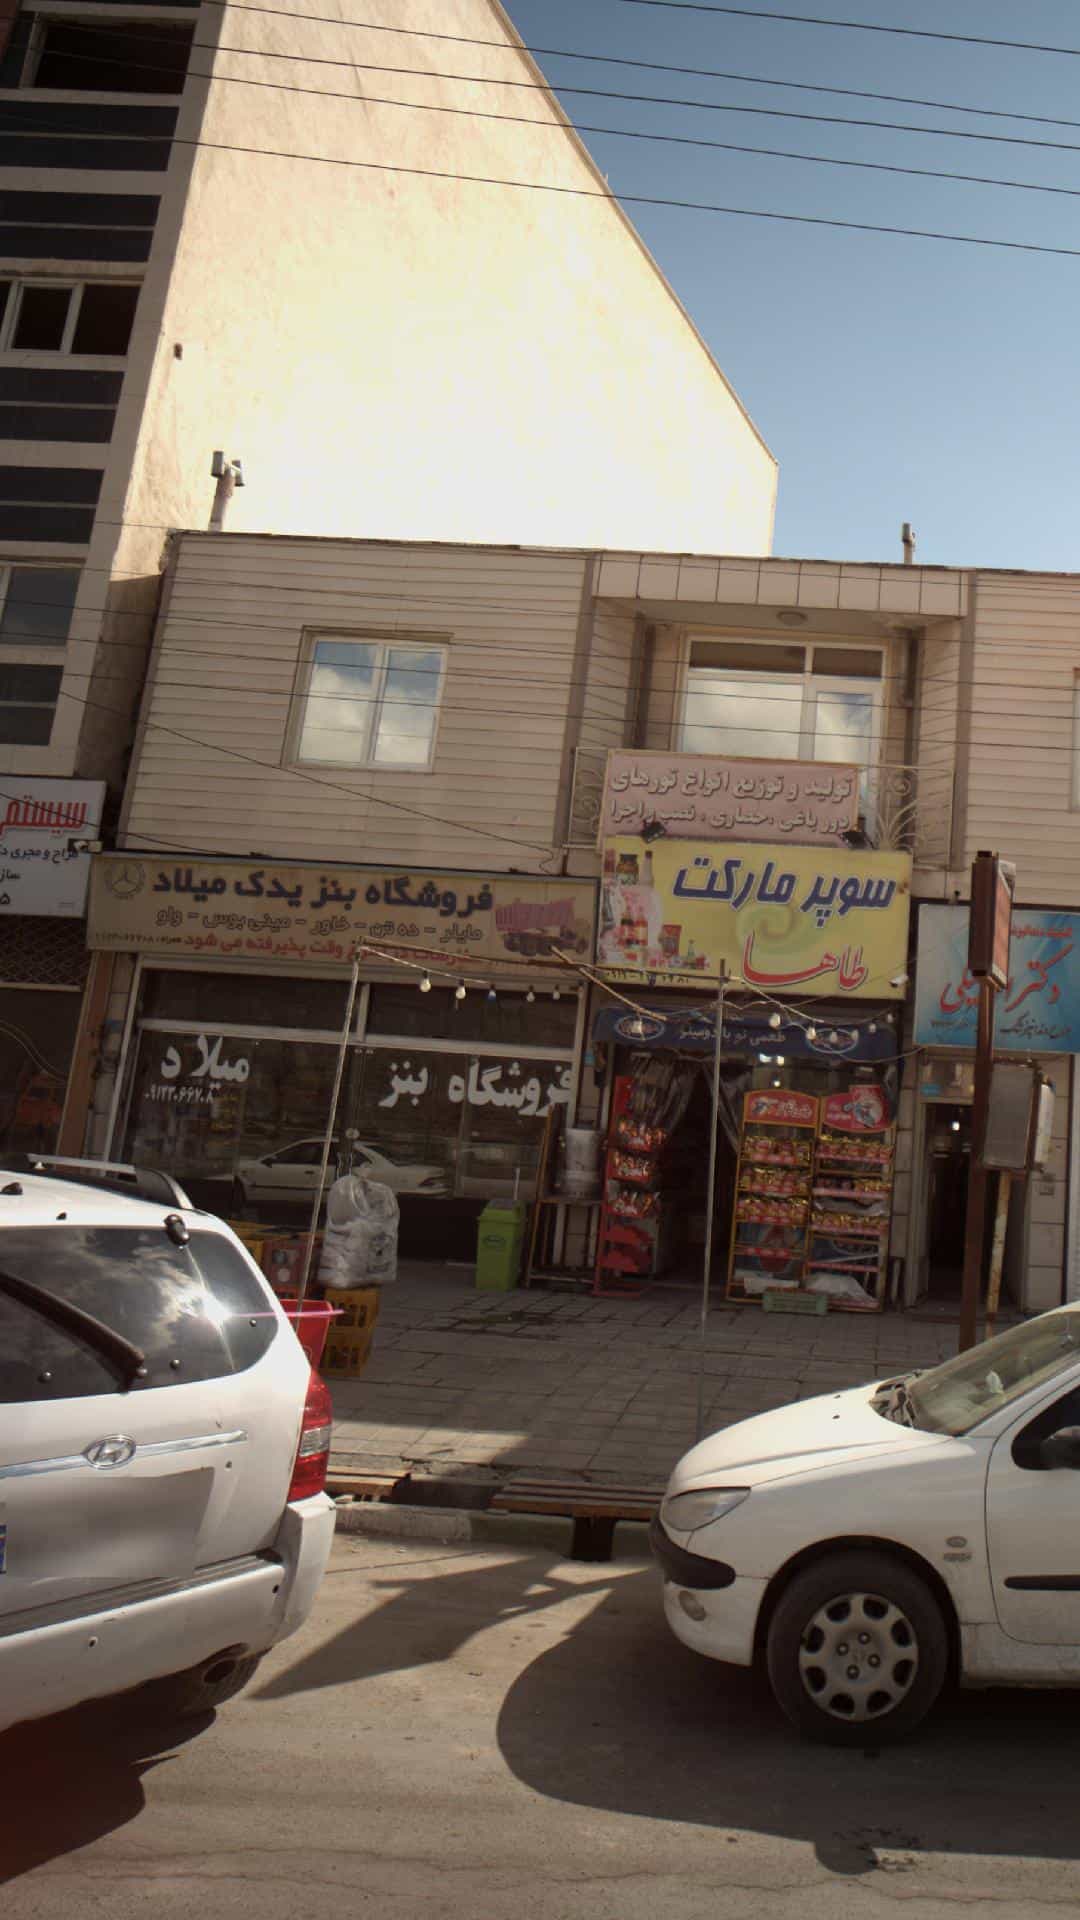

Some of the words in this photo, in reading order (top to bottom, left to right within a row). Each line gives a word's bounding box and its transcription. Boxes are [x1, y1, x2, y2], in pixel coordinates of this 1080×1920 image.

[681, 769, 730, 796] انواع
[734, 775, 785, 800] توزیع
[788, 783, 799, 800] و
[805, 775, 854, 802] تولید
[610, 799, 646, 823] اجرا
[152, 866, 228, 903] میلاد
[233, 869, 304, 909] یدک
[309, 874, 357, 912] بنز
[365, 875, 495, 918] فروشگاه
[672, 856, 798, 912] مارکت
[800, 873, 898, 928] سوپر
[183, 932, 218, 951] شود
[309, 914, 351, 936] خاور
[220, 936, 243, 953] می
[309, 938, 344, 959] وقت
[742, 930, 868, 991] طاها
[1004, 944, 1074, 1013] دکتر
[160, 1034, 250, 1090] میلاد
[377, 1060, 429, 1108] بنز
[448, 1055, 574, 1118] فروشگاه
